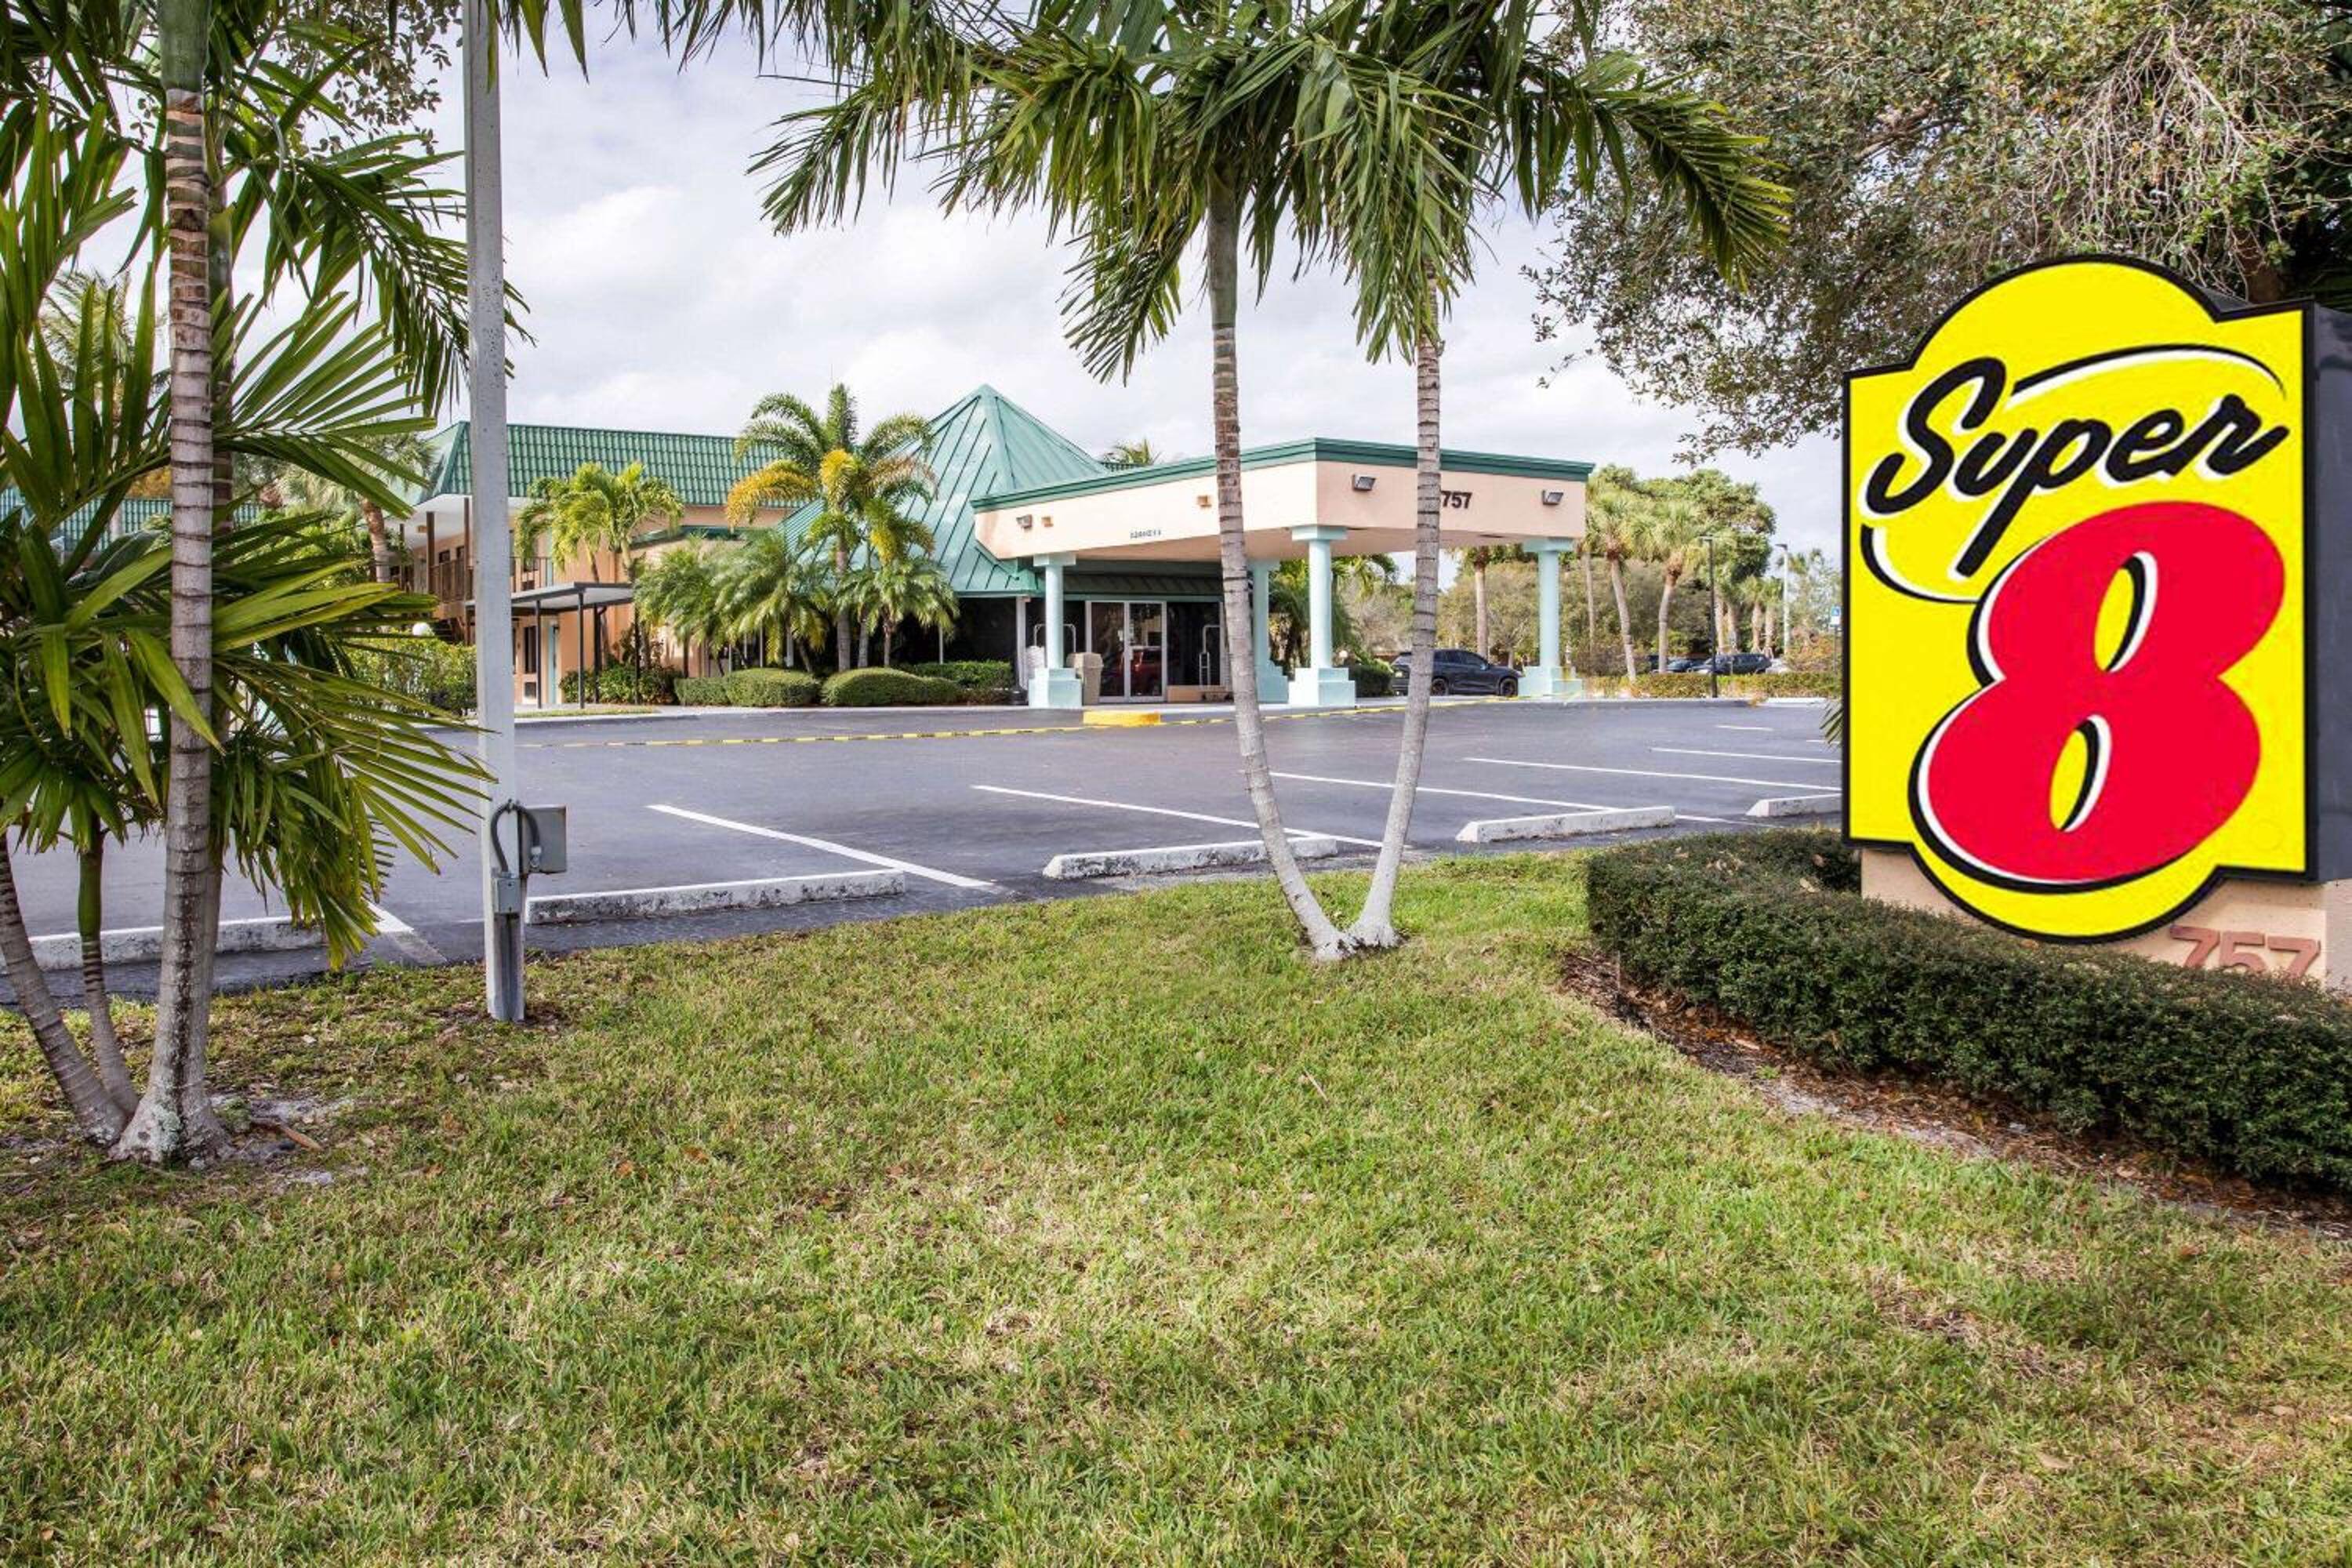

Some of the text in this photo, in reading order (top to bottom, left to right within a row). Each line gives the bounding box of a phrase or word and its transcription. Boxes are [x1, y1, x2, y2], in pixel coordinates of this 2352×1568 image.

[1441, 490, 1473, 509] 757
[1861, 356, 2291, 579] Super
[1907, 500, 2286, 895] 8
[2169, 924, 2321, 981] 757
